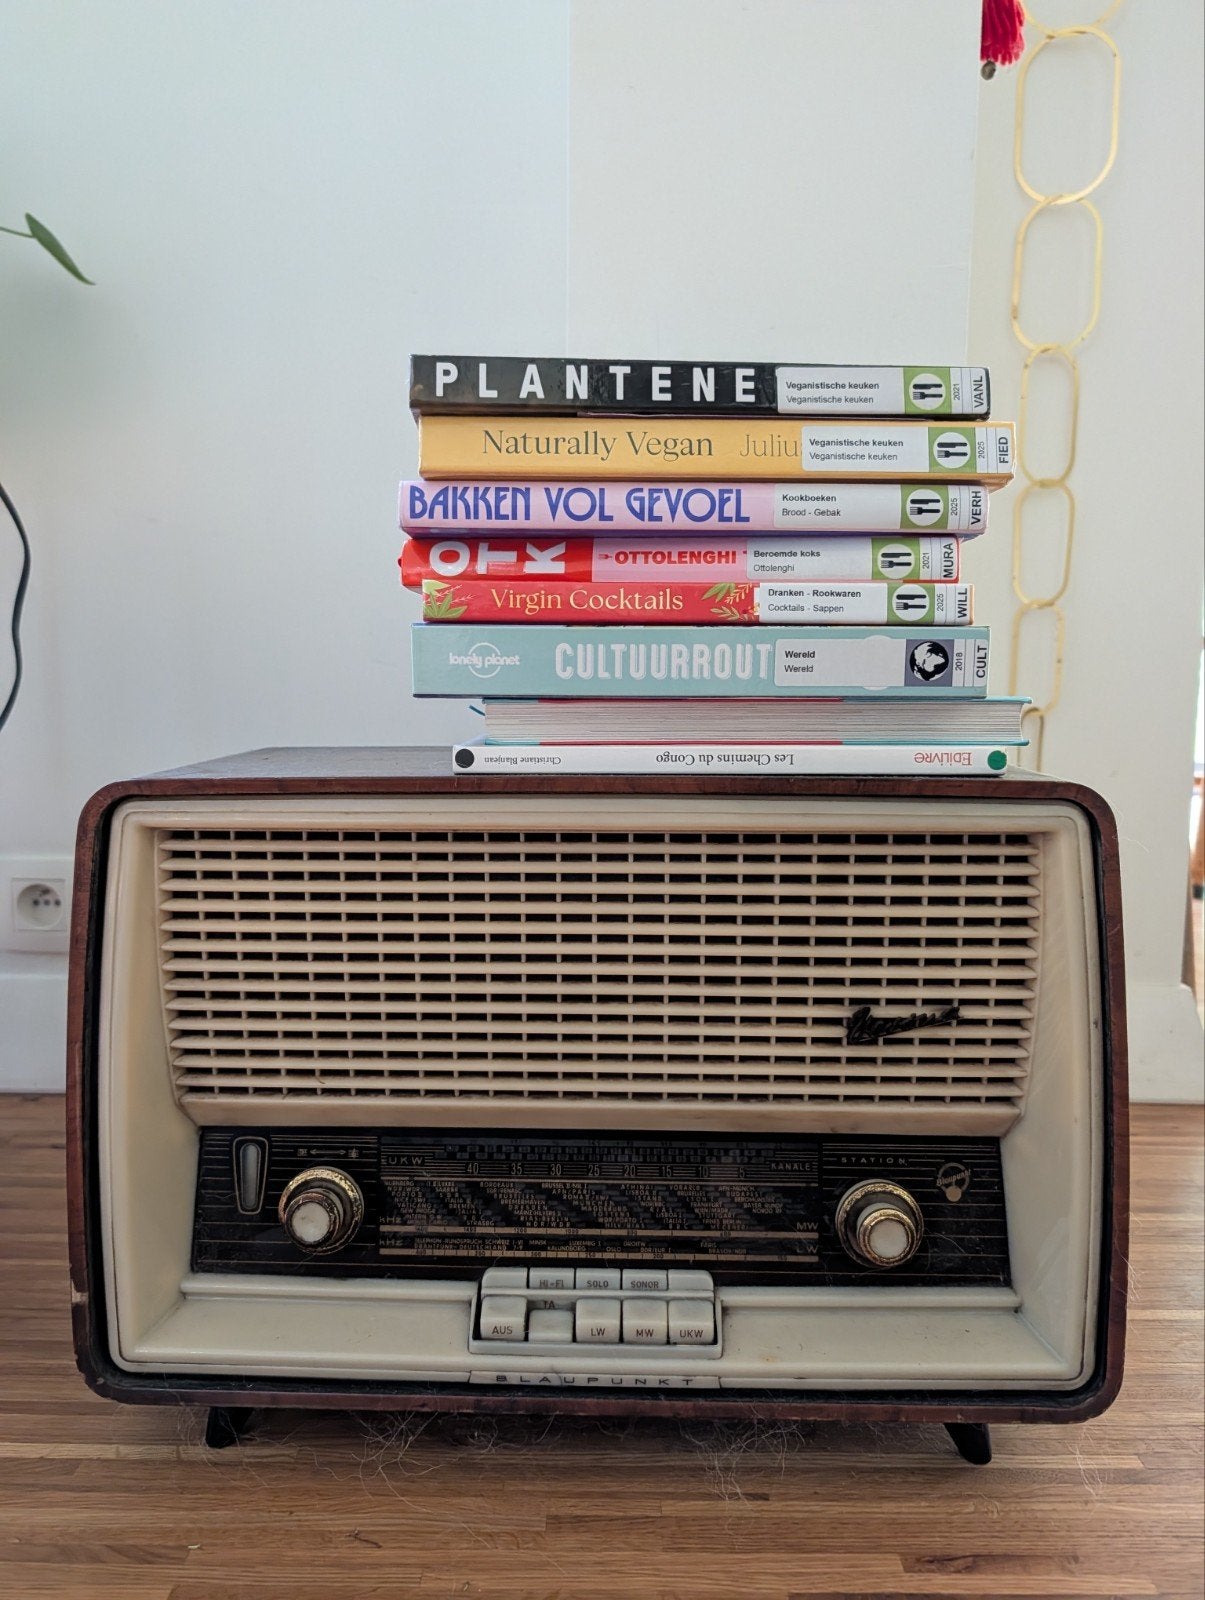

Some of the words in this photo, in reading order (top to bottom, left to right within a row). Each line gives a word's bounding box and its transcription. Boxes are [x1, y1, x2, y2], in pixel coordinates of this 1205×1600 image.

[435, 361, 756, 403] PLANTENE
[785, 381, 846, 391] Veganistische
[847, 381, 880, 390] keuken
[952, 383, 961, 401] 2021
[973, 375, 984, 409] VANL
[785, 395, 846, 405] Veganistische
[847, 395, 874, 404] keuken
[482, 429, 617, 461] Naturally
[626, 431, 714, 462] Vegan
[739, 433, 803, 457] Juliu
[809, 438, 870, 448] Veganistische
[872, 439, 904, 447] keuken
[977, 440, 986, 459] 2025
[998, 436, 1009, 464] FIED
[809, 452, 866, 462] Veganistische
[867, 452, 898, 461] keuken
[409, 485, 531, 520] BAKKEN
[544, 487, 614, 522] VOL
[625, 487, 750, 523] GEVOEL
[782, 493, 836, 503] Kookboeken
[782, 508, 806, 517] Brood
[814, 508, 841, 517] Gebak
[950, 497, 958, 517] 2025
[970, 490, 982, 524] VERH
[614, 551, 736, 565] OTTOLENGHI
[753, 550, 798, 558] Beroemde
[800, 550, 821, 558] koks
[922, 552, 930, 569] 2021
[943, 542, 953, 578] MURA
[753, 564, 795, 573] Ottolenghi
[768, 588, 805, 597] Dranken
[812, 589, 862, 598] Rookwaren
[491, 588, 562, 615] Virgin
[569, 588, 684, 611] Cocktails
[767, 603, 805, 612] Cocktails
[812, 604, 845, 613] Sappen
[936, 593, 944, 612] 2025
[957, 587, 968, 619] WILL
[449, 652, 482, 669] lonely
[484, 652, 520, 668] planet
[784, 650, 816, 659] Wereld
[954, 652, 963, 671] 2018
[975, 644, 988, 679] CULT
[783, 664, 814, 673] Wereld
[484, 754, 518, 765] Blanjean
[519, 755, 562, 765] Christiane
[656, 751, 695, 765] Congo
[698, 753, 714, 765] du
[730, 753, 771, 766] Chemins
[778, 753, 794, 766] Les
[388, 1156, 423, 1165] UKW
[466, 1162, 479, 1175] 40
[510, 1163, 523, 1175] 35
[550, 1163, 562, 1176] 30
[588, 1164, 600, 1176] 25
[624, 1165, 636, 1177] 20
[661, 1166, 672, 1178] 15
[698, 1166, 709, 1179] 10
[936, 1168, 972, 1187] Blaupunkt
[796, 1222, 819, 1231] MW
[539, 1279, 564, 1288] HI-FI
[586, 1279, 609, 1288] SOLO
[630, 1280, 659, 1289] SONOR
[543, 1300, 555, 1309] TA
[491, 1325, 513, 1335] AUS
[590, 1328, 606, 1337] LW
[635, 1328, 654, 1338] MW
[679, 1329, 704, 1339] UKW
[495, 1374, 693, 1386] BLAUPUNKT
